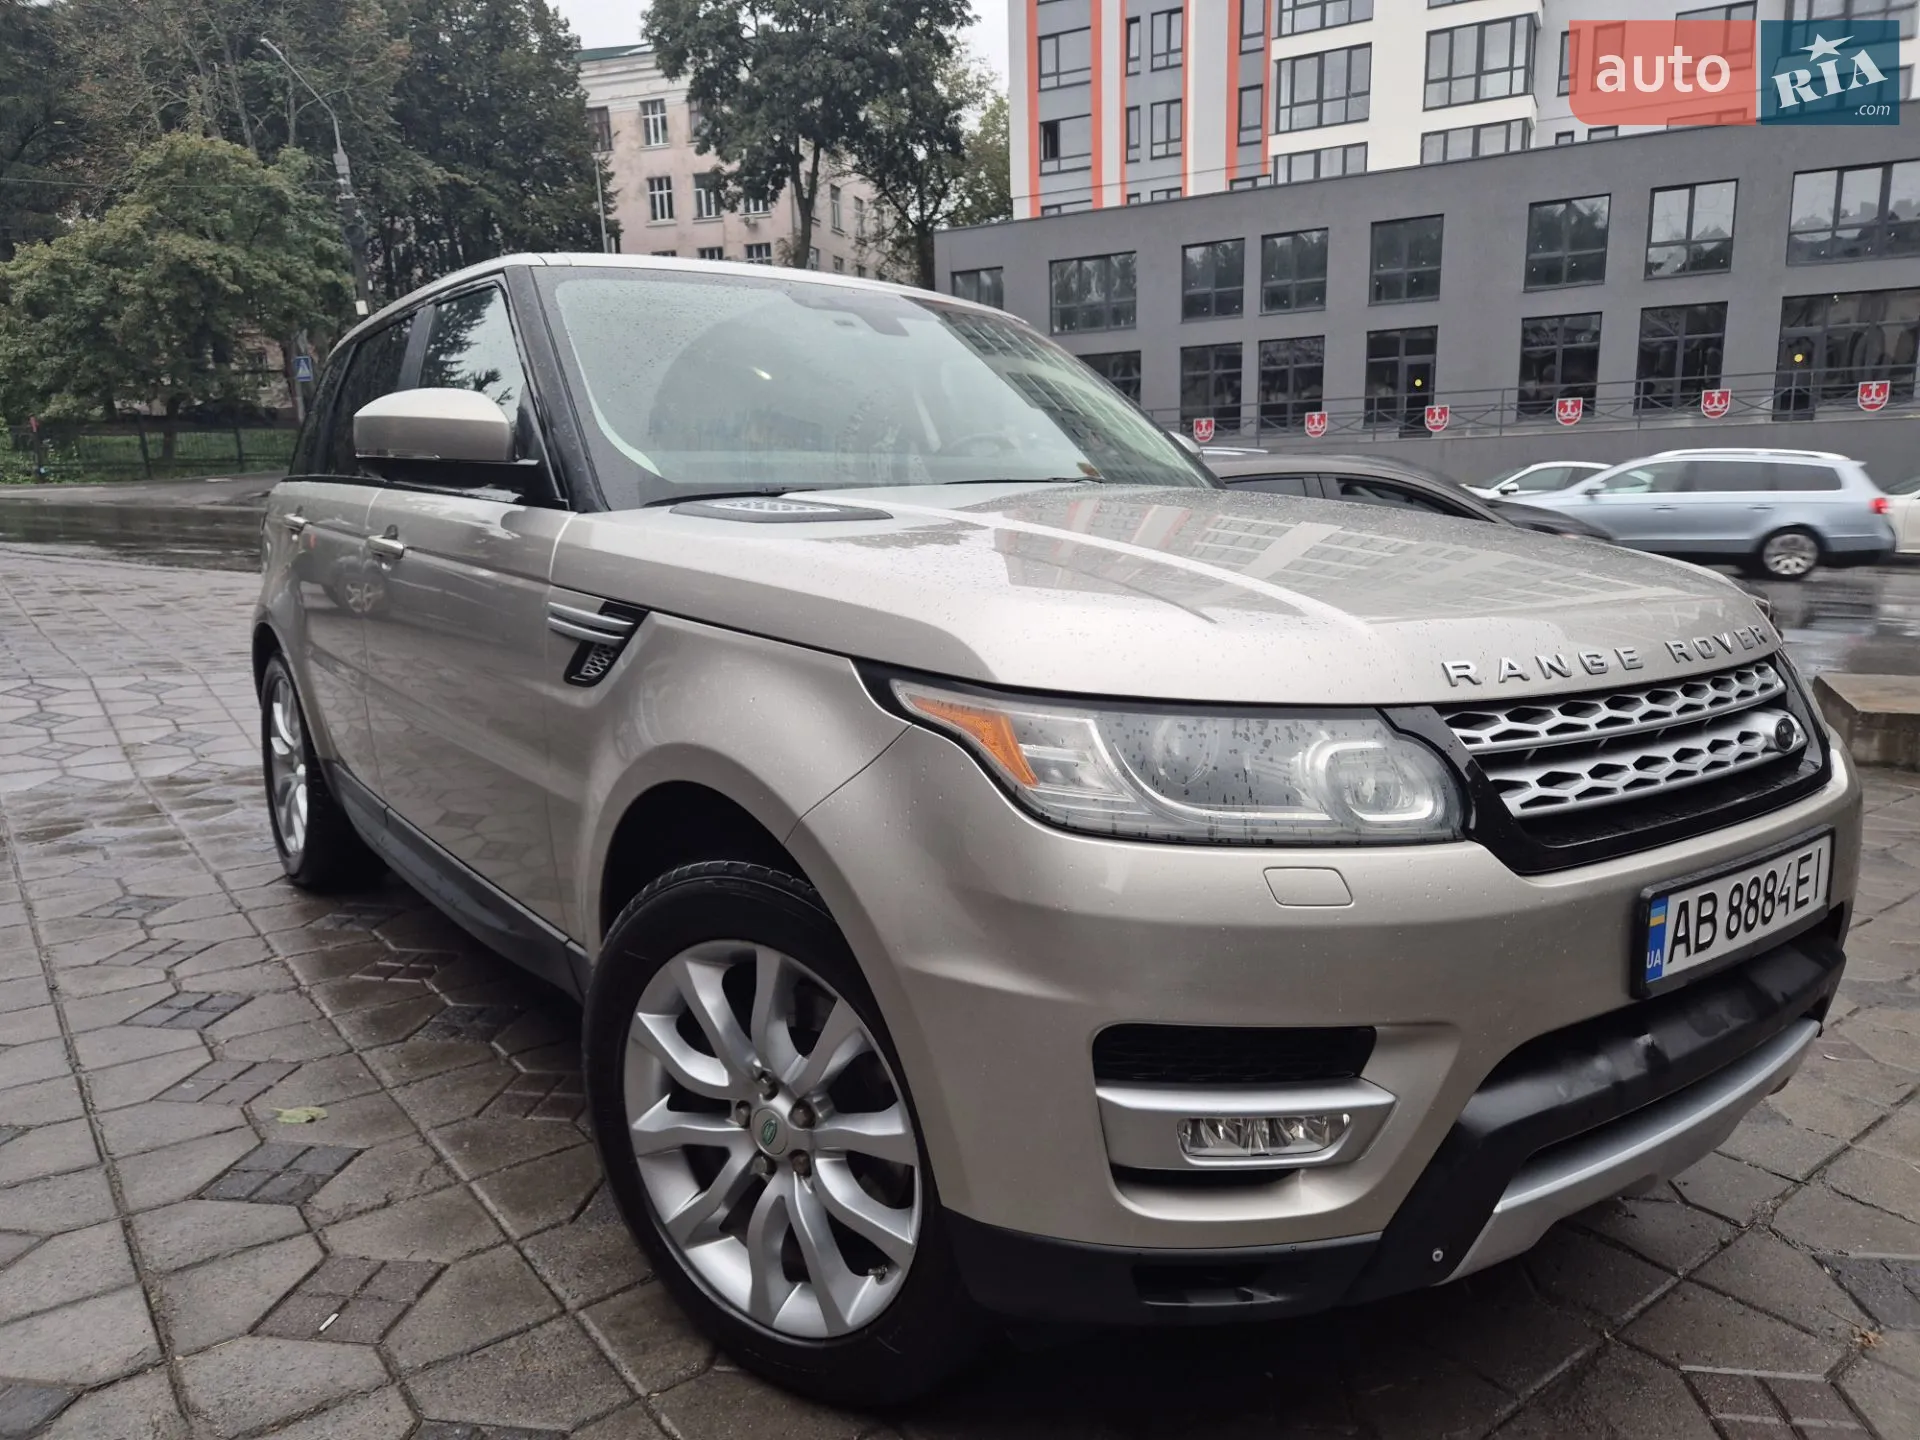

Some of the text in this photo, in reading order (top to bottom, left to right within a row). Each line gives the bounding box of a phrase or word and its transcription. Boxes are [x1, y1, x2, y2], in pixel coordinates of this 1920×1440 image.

[1440, 624, 1769, 688] RANGE ROVER
[1725, 860, 1792, 940] 8884
[1646, 949, 1662, 969] UA
